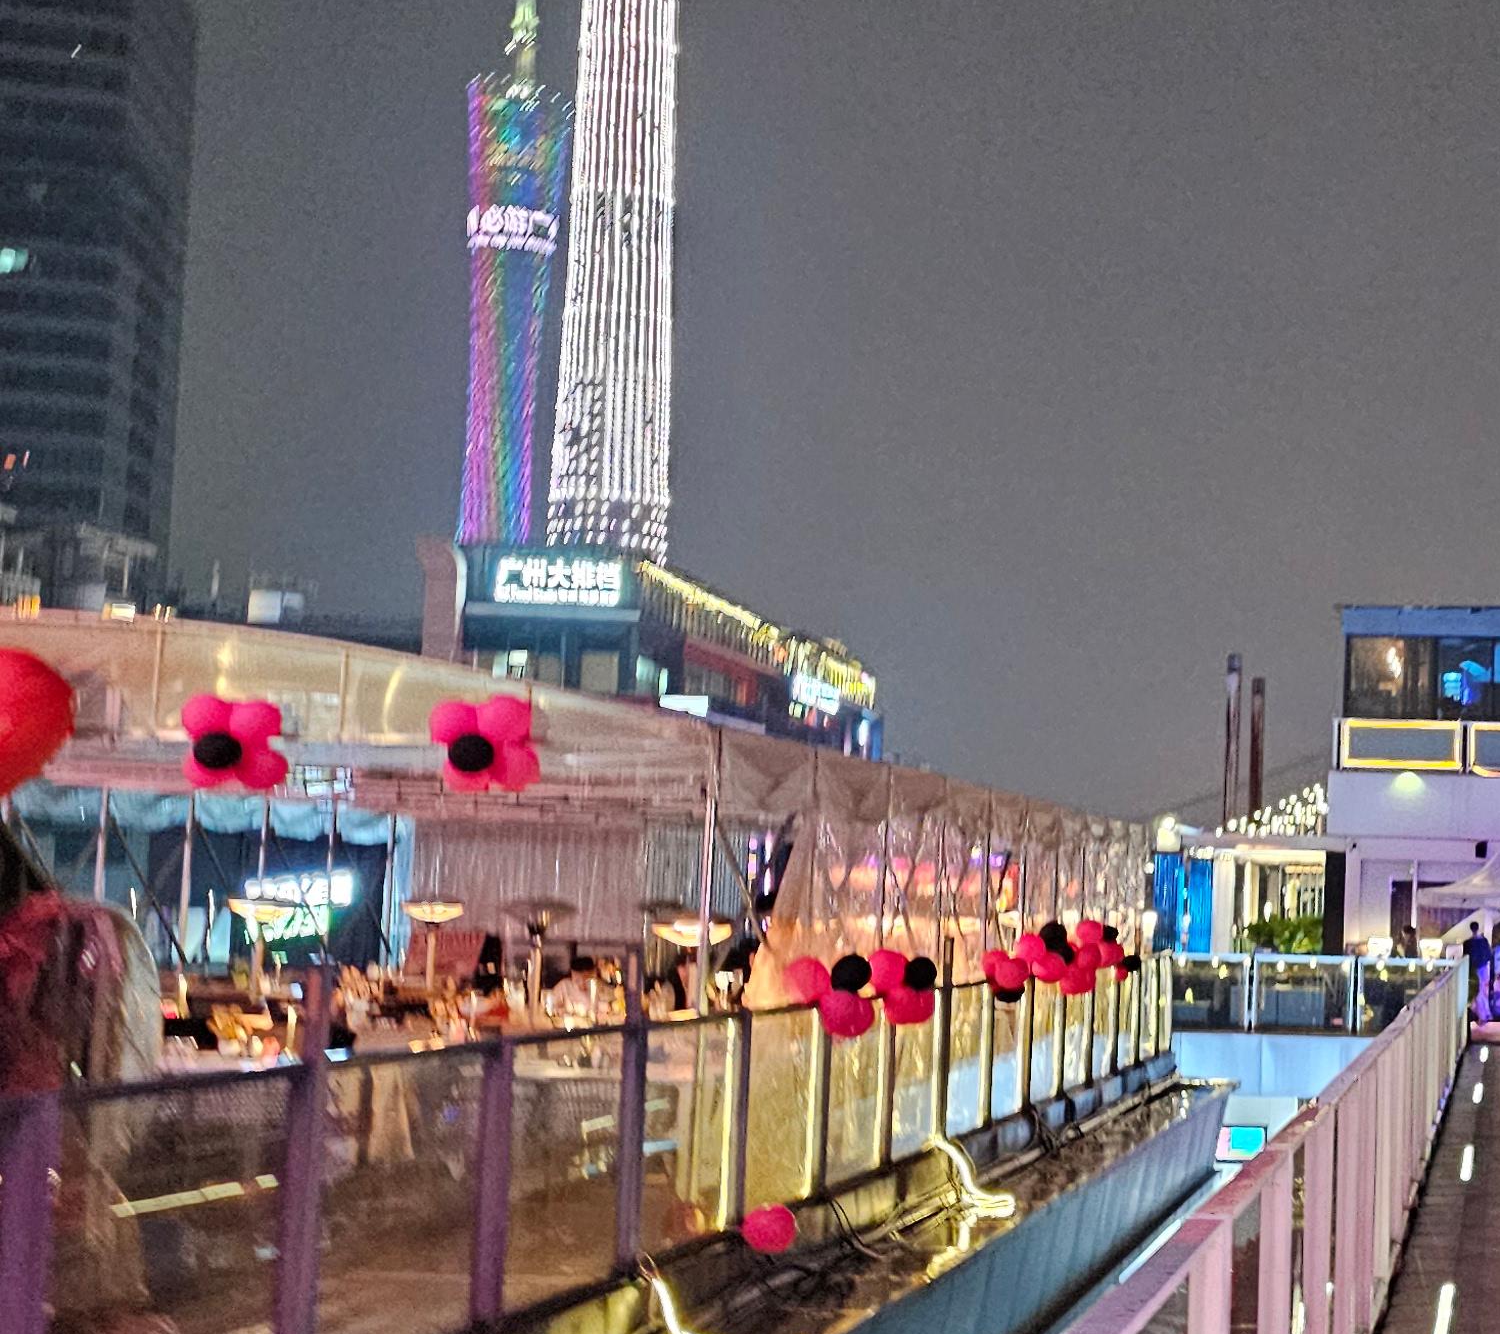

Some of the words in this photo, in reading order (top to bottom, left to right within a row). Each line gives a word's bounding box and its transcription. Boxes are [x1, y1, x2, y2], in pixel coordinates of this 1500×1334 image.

[496, 555, 622, 591] 广州大排档
